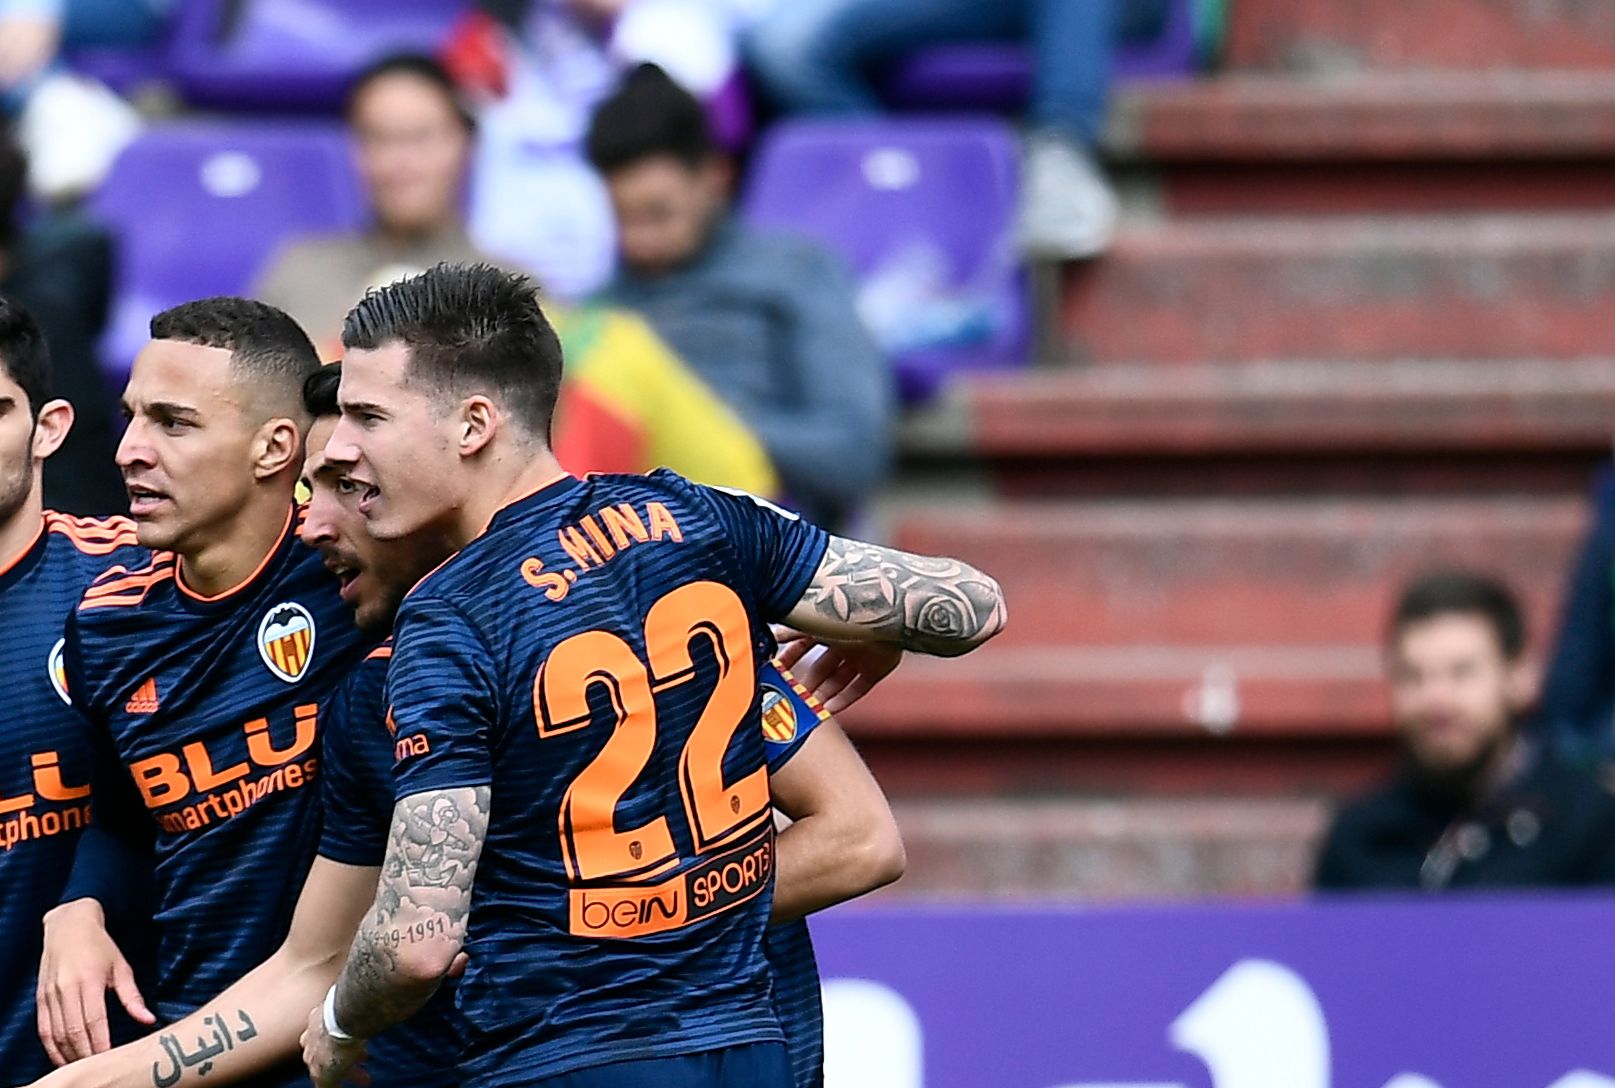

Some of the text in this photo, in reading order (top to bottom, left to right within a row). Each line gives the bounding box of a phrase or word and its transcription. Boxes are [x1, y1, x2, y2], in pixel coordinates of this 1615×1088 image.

[520, 502, 683, 602] S.MINA
[533, 580, 771, 884] 22
[156, 759, 317, 832] martphones
[153, 1009, 257, 1088] دانيال
